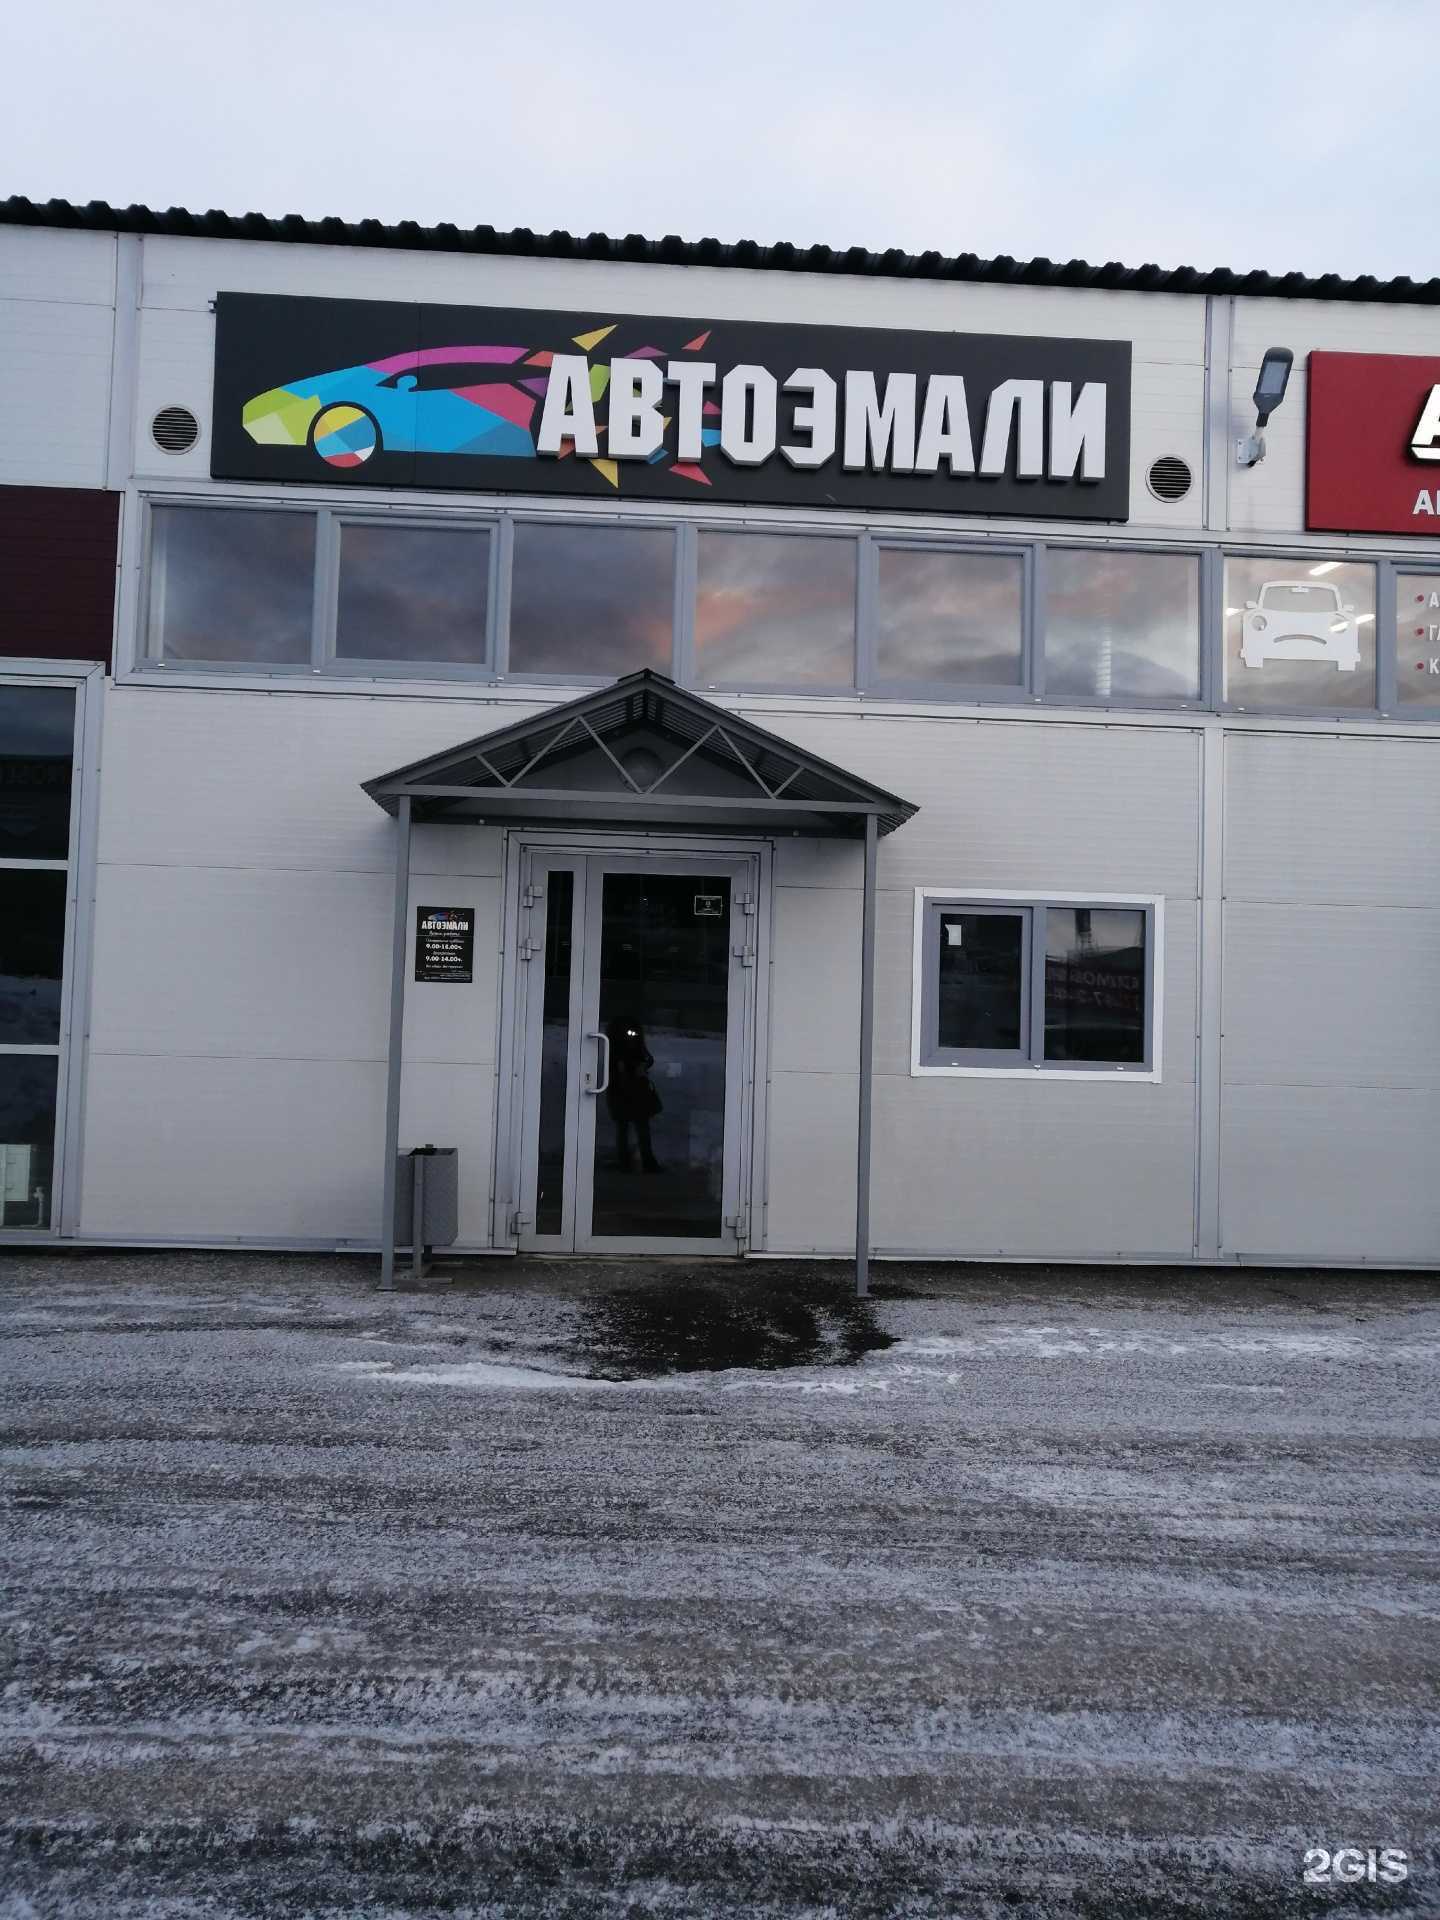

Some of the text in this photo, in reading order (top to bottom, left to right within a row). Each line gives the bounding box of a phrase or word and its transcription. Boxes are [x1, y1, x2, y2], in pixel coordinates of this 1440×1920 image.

[537, 354, 1106, 481] АВТОЭМАЛИ
[1412, 489, 1440, 515] А
[421, 920, 469, 931] АВТОЭМАЛИ
